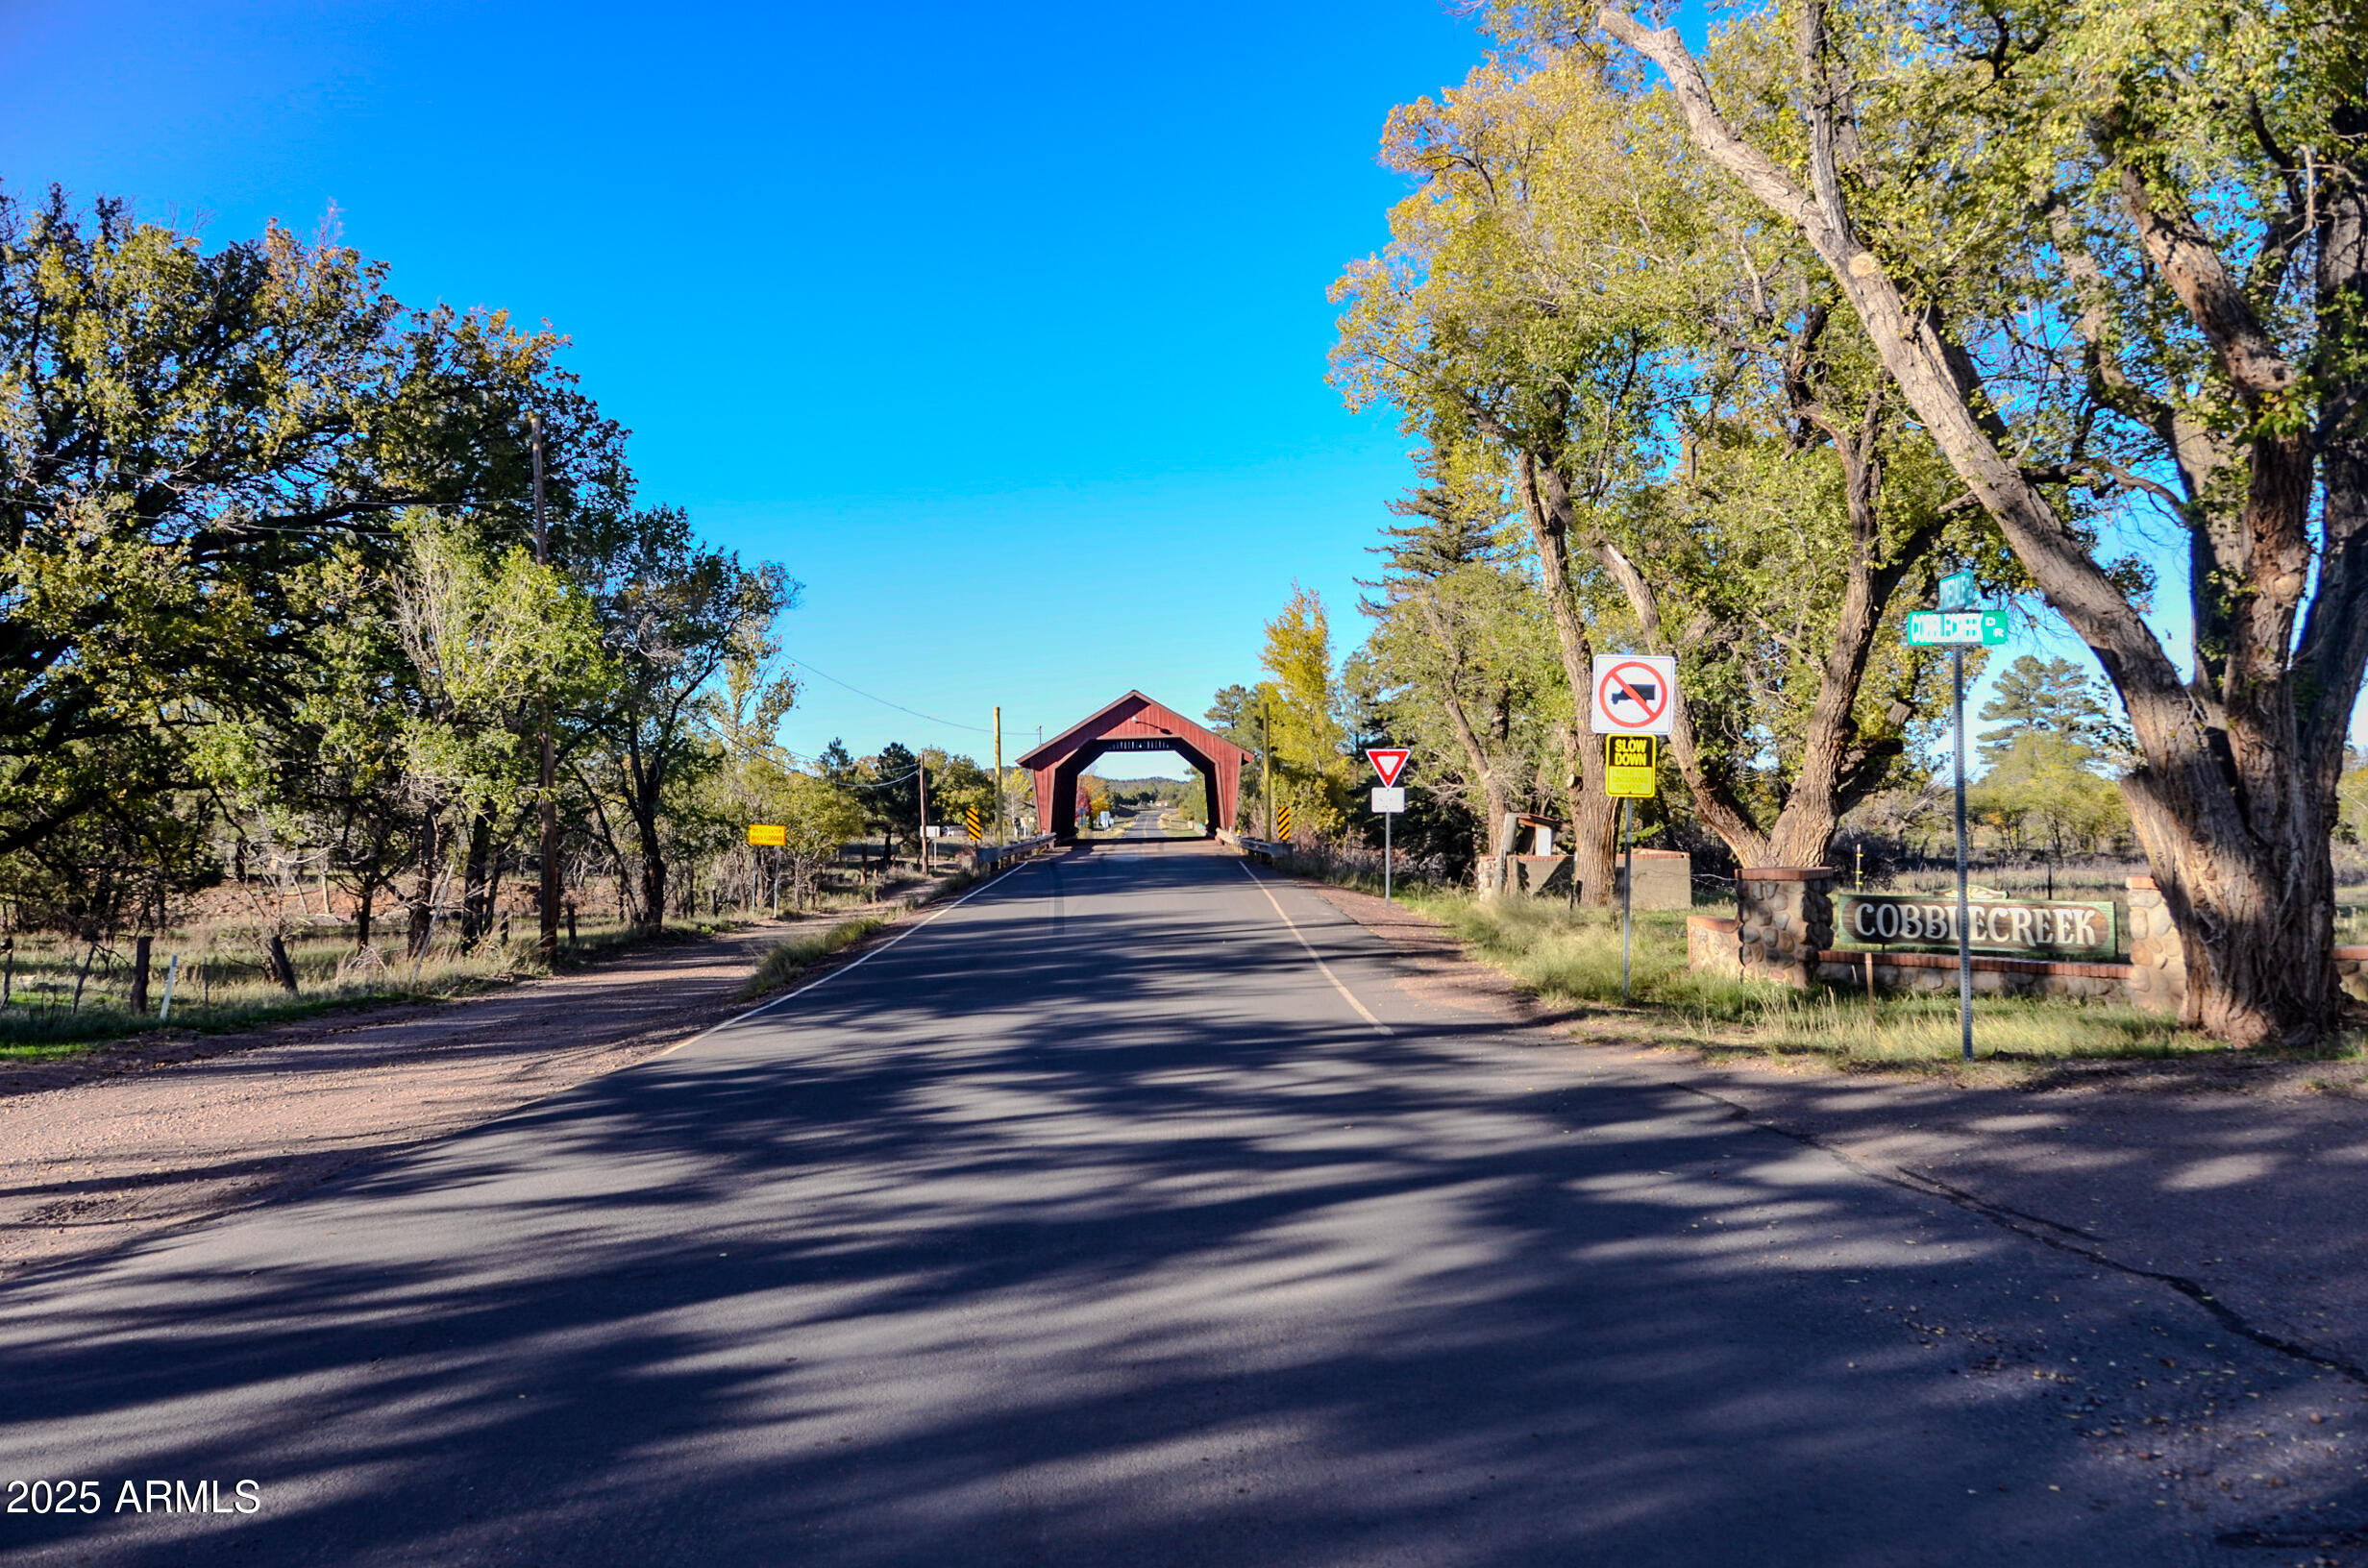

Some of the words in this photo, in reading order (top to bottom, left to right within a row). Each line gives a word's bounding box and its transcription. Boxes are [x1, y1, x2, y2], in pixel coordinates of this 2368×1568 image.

[1615, 739, 1647, 752] SLOW
[1615, 752, 1647, 766] DOWN
[1855, 902, 2097, 946] COBBLECREEK
